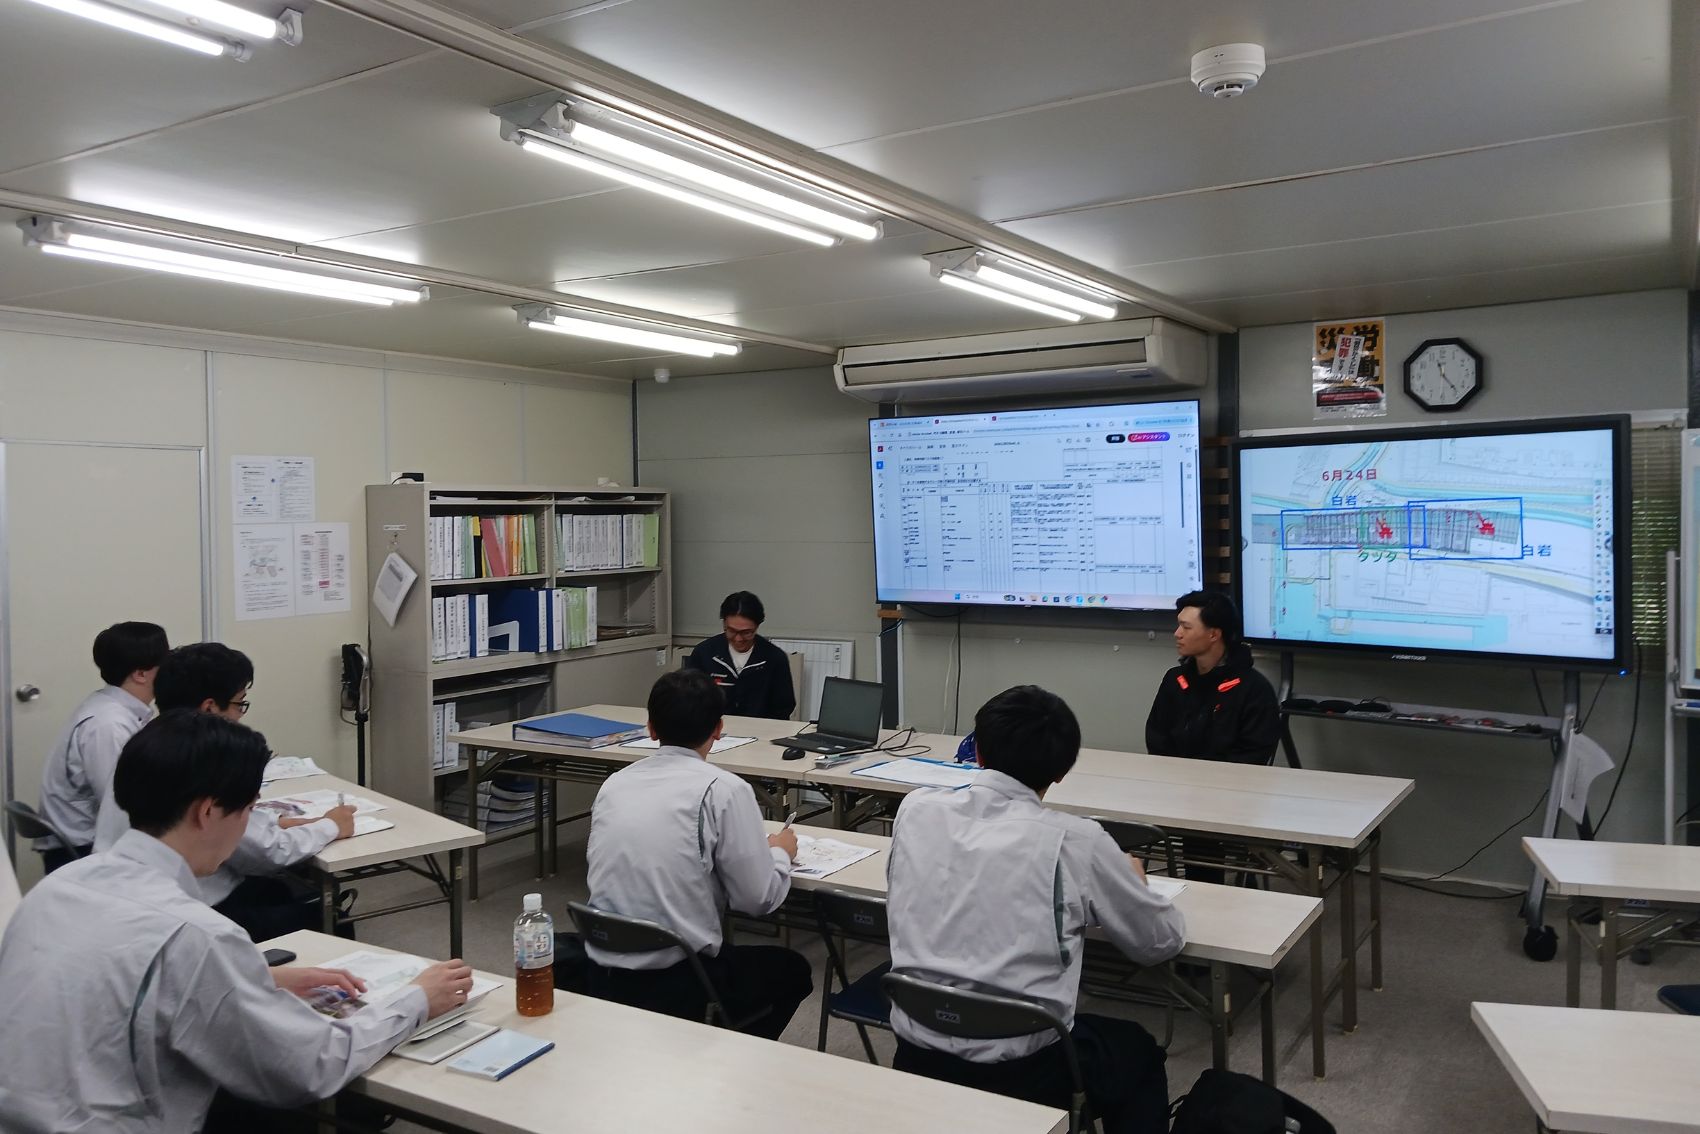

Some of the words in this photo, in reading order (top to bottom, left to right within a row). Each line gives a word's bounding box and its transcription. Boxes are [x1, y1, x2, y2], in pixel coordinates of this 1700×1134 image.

[1322, 468, 1377, 482] 6月24日
[1332, 494, 1357, 506] 白岩
[1521, 544, 1552, 557] 白岩
